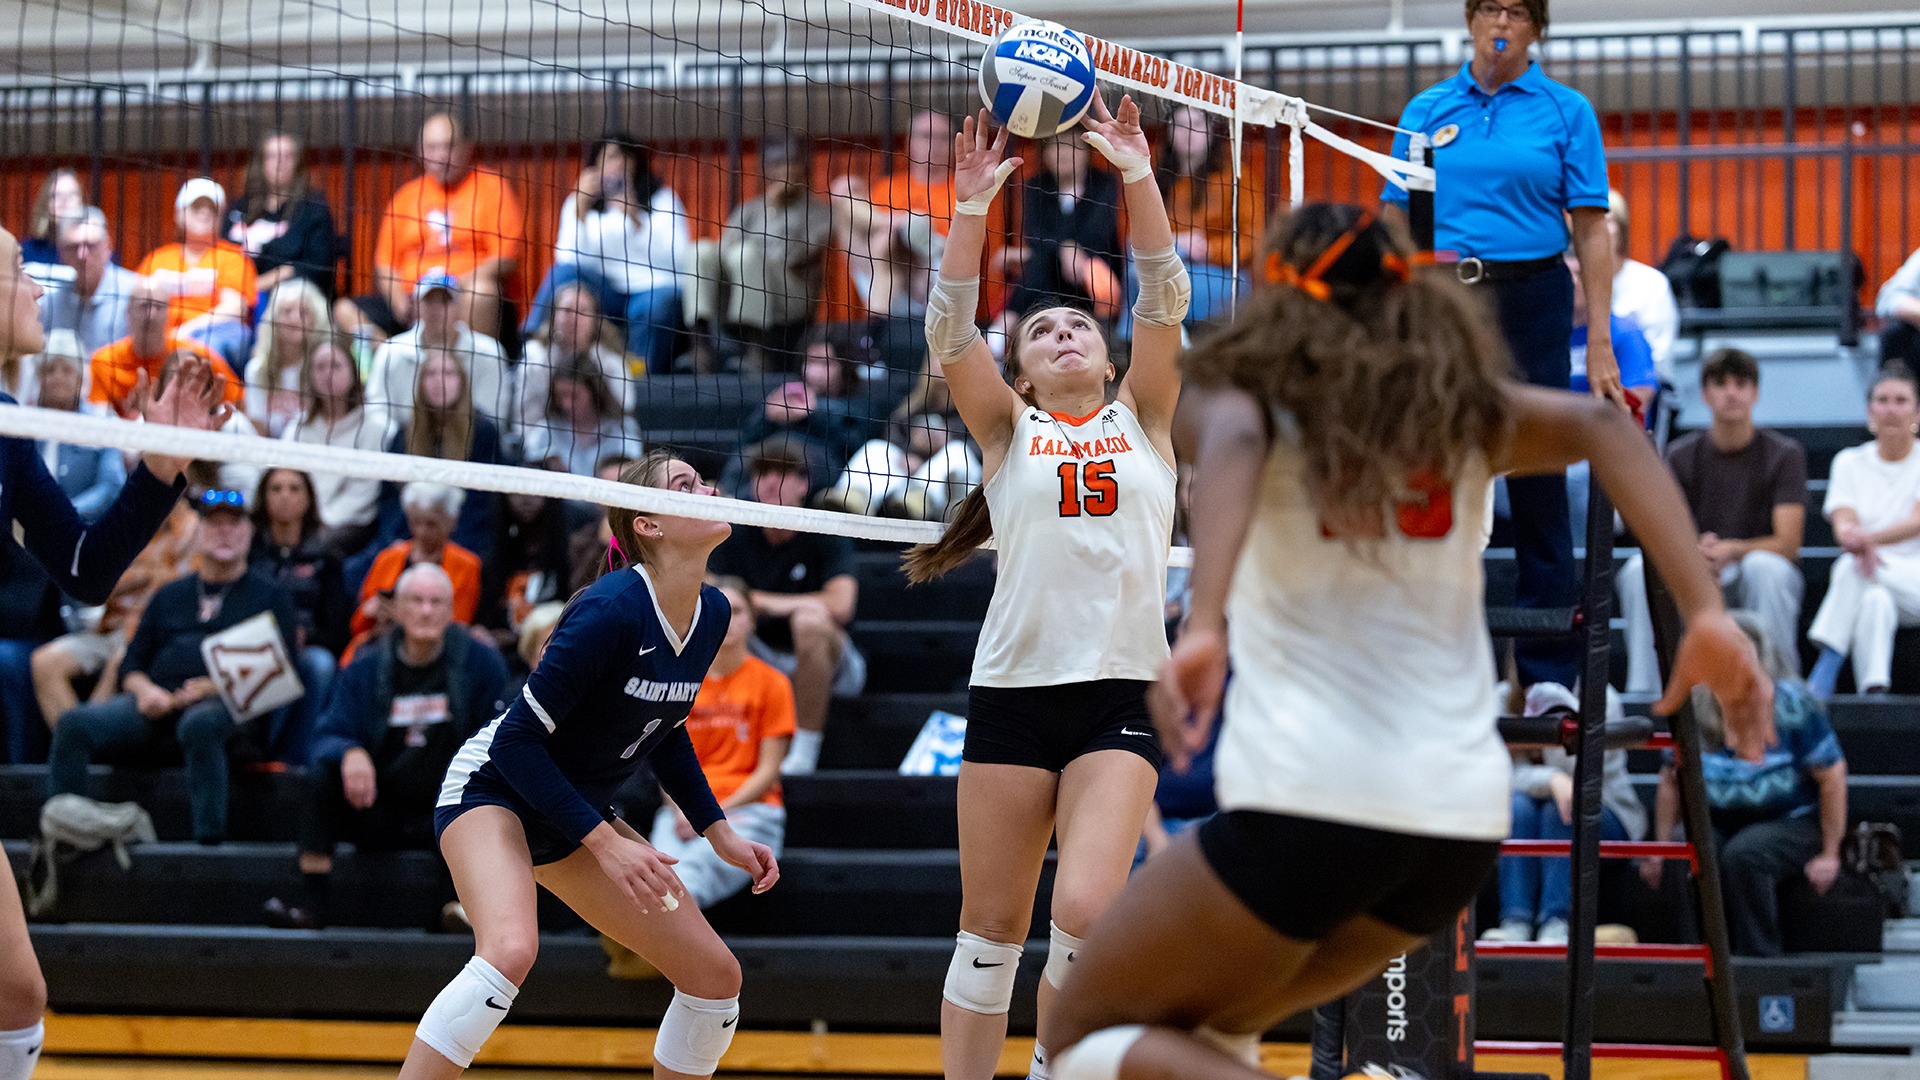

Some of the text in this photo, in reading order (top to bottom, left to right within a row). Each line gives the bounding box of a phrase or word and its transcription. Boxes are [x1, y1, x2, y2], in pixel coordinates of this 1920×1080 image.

[936, 0, 1013, 38] HORNETS
[1014, 40, 1073, 72] NCAA
[1018, 28, 1080, 56] molten
[1056, 458, 1119, 518] 15
[623, 676, 669, 702] SAINT
[620, 718, 663, 760] 1
